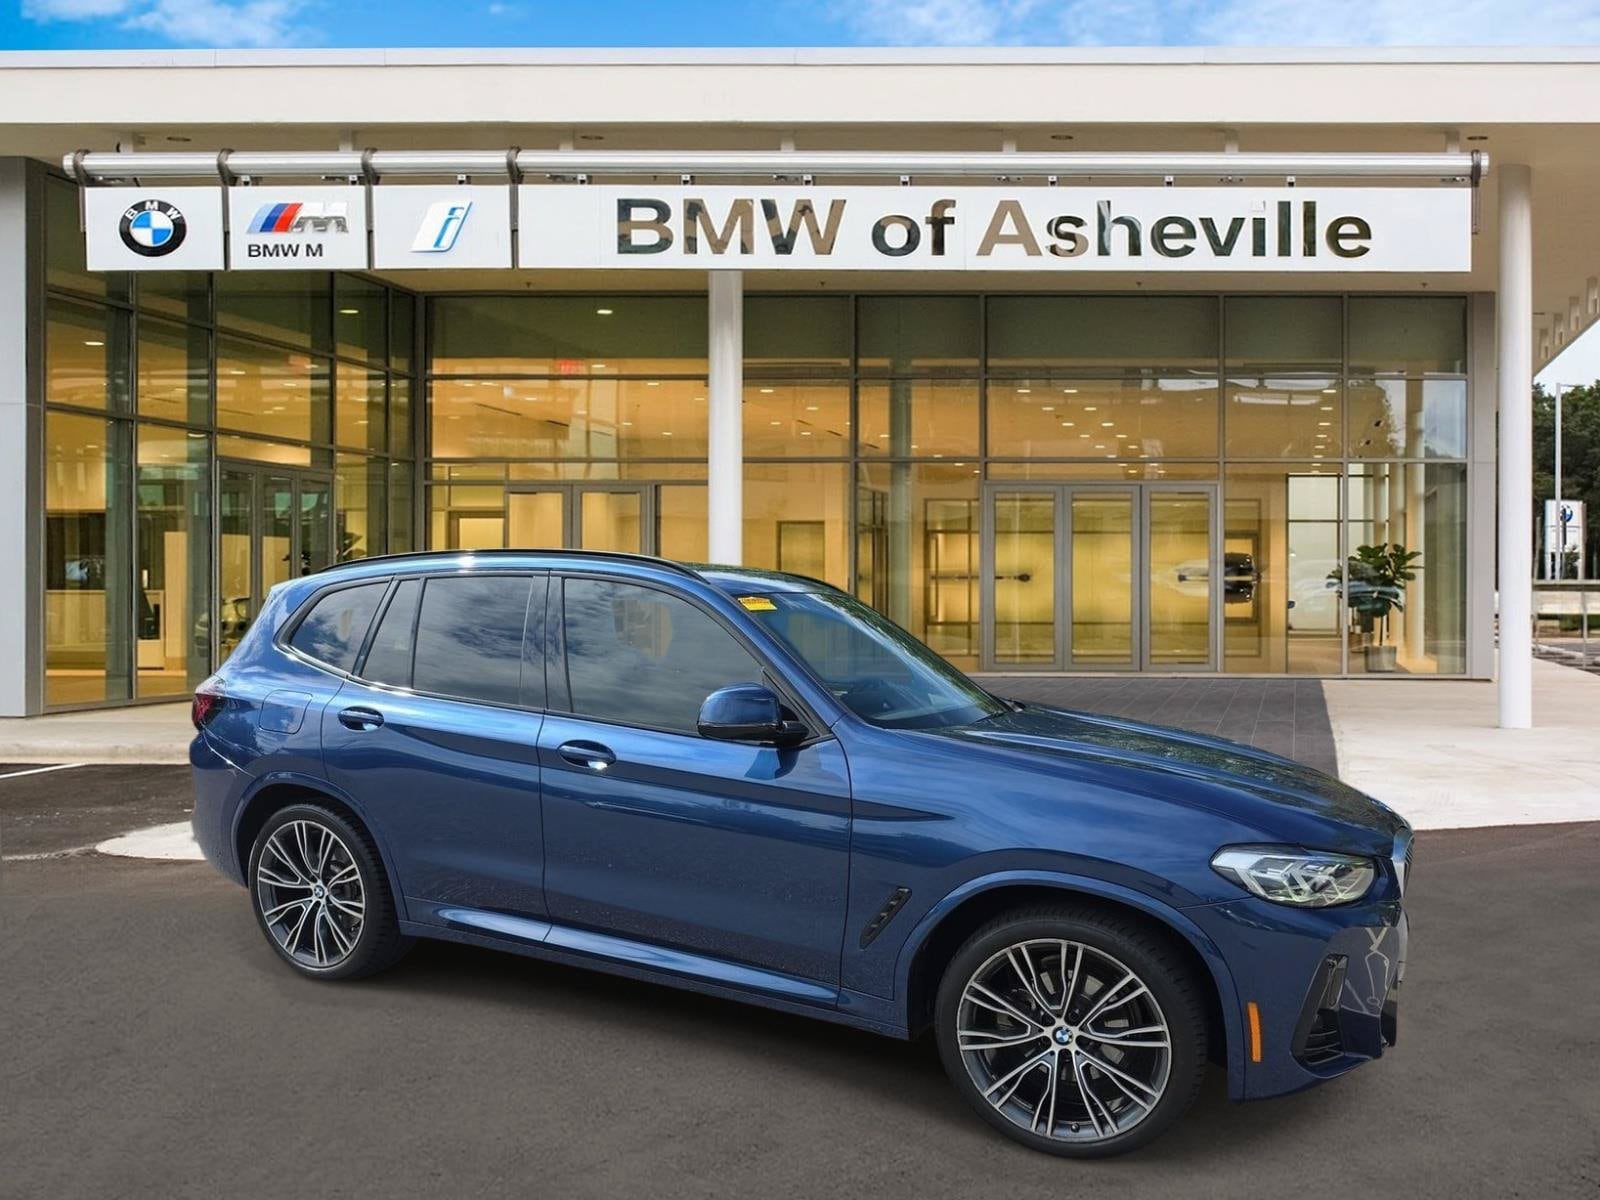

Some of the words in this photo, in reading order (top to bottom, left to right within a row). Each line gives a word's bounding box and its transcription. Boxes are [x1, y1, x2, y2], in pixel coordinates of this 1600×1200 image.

[125, 201, 182, 220] BMW
[616, 199, 847, 255] BMW
[871, 199, 957, 257] of
[976, 200, 1373, 258] Asheville
[247, 244, 300, 258] BMW
[305, 244, 324, 258] M
